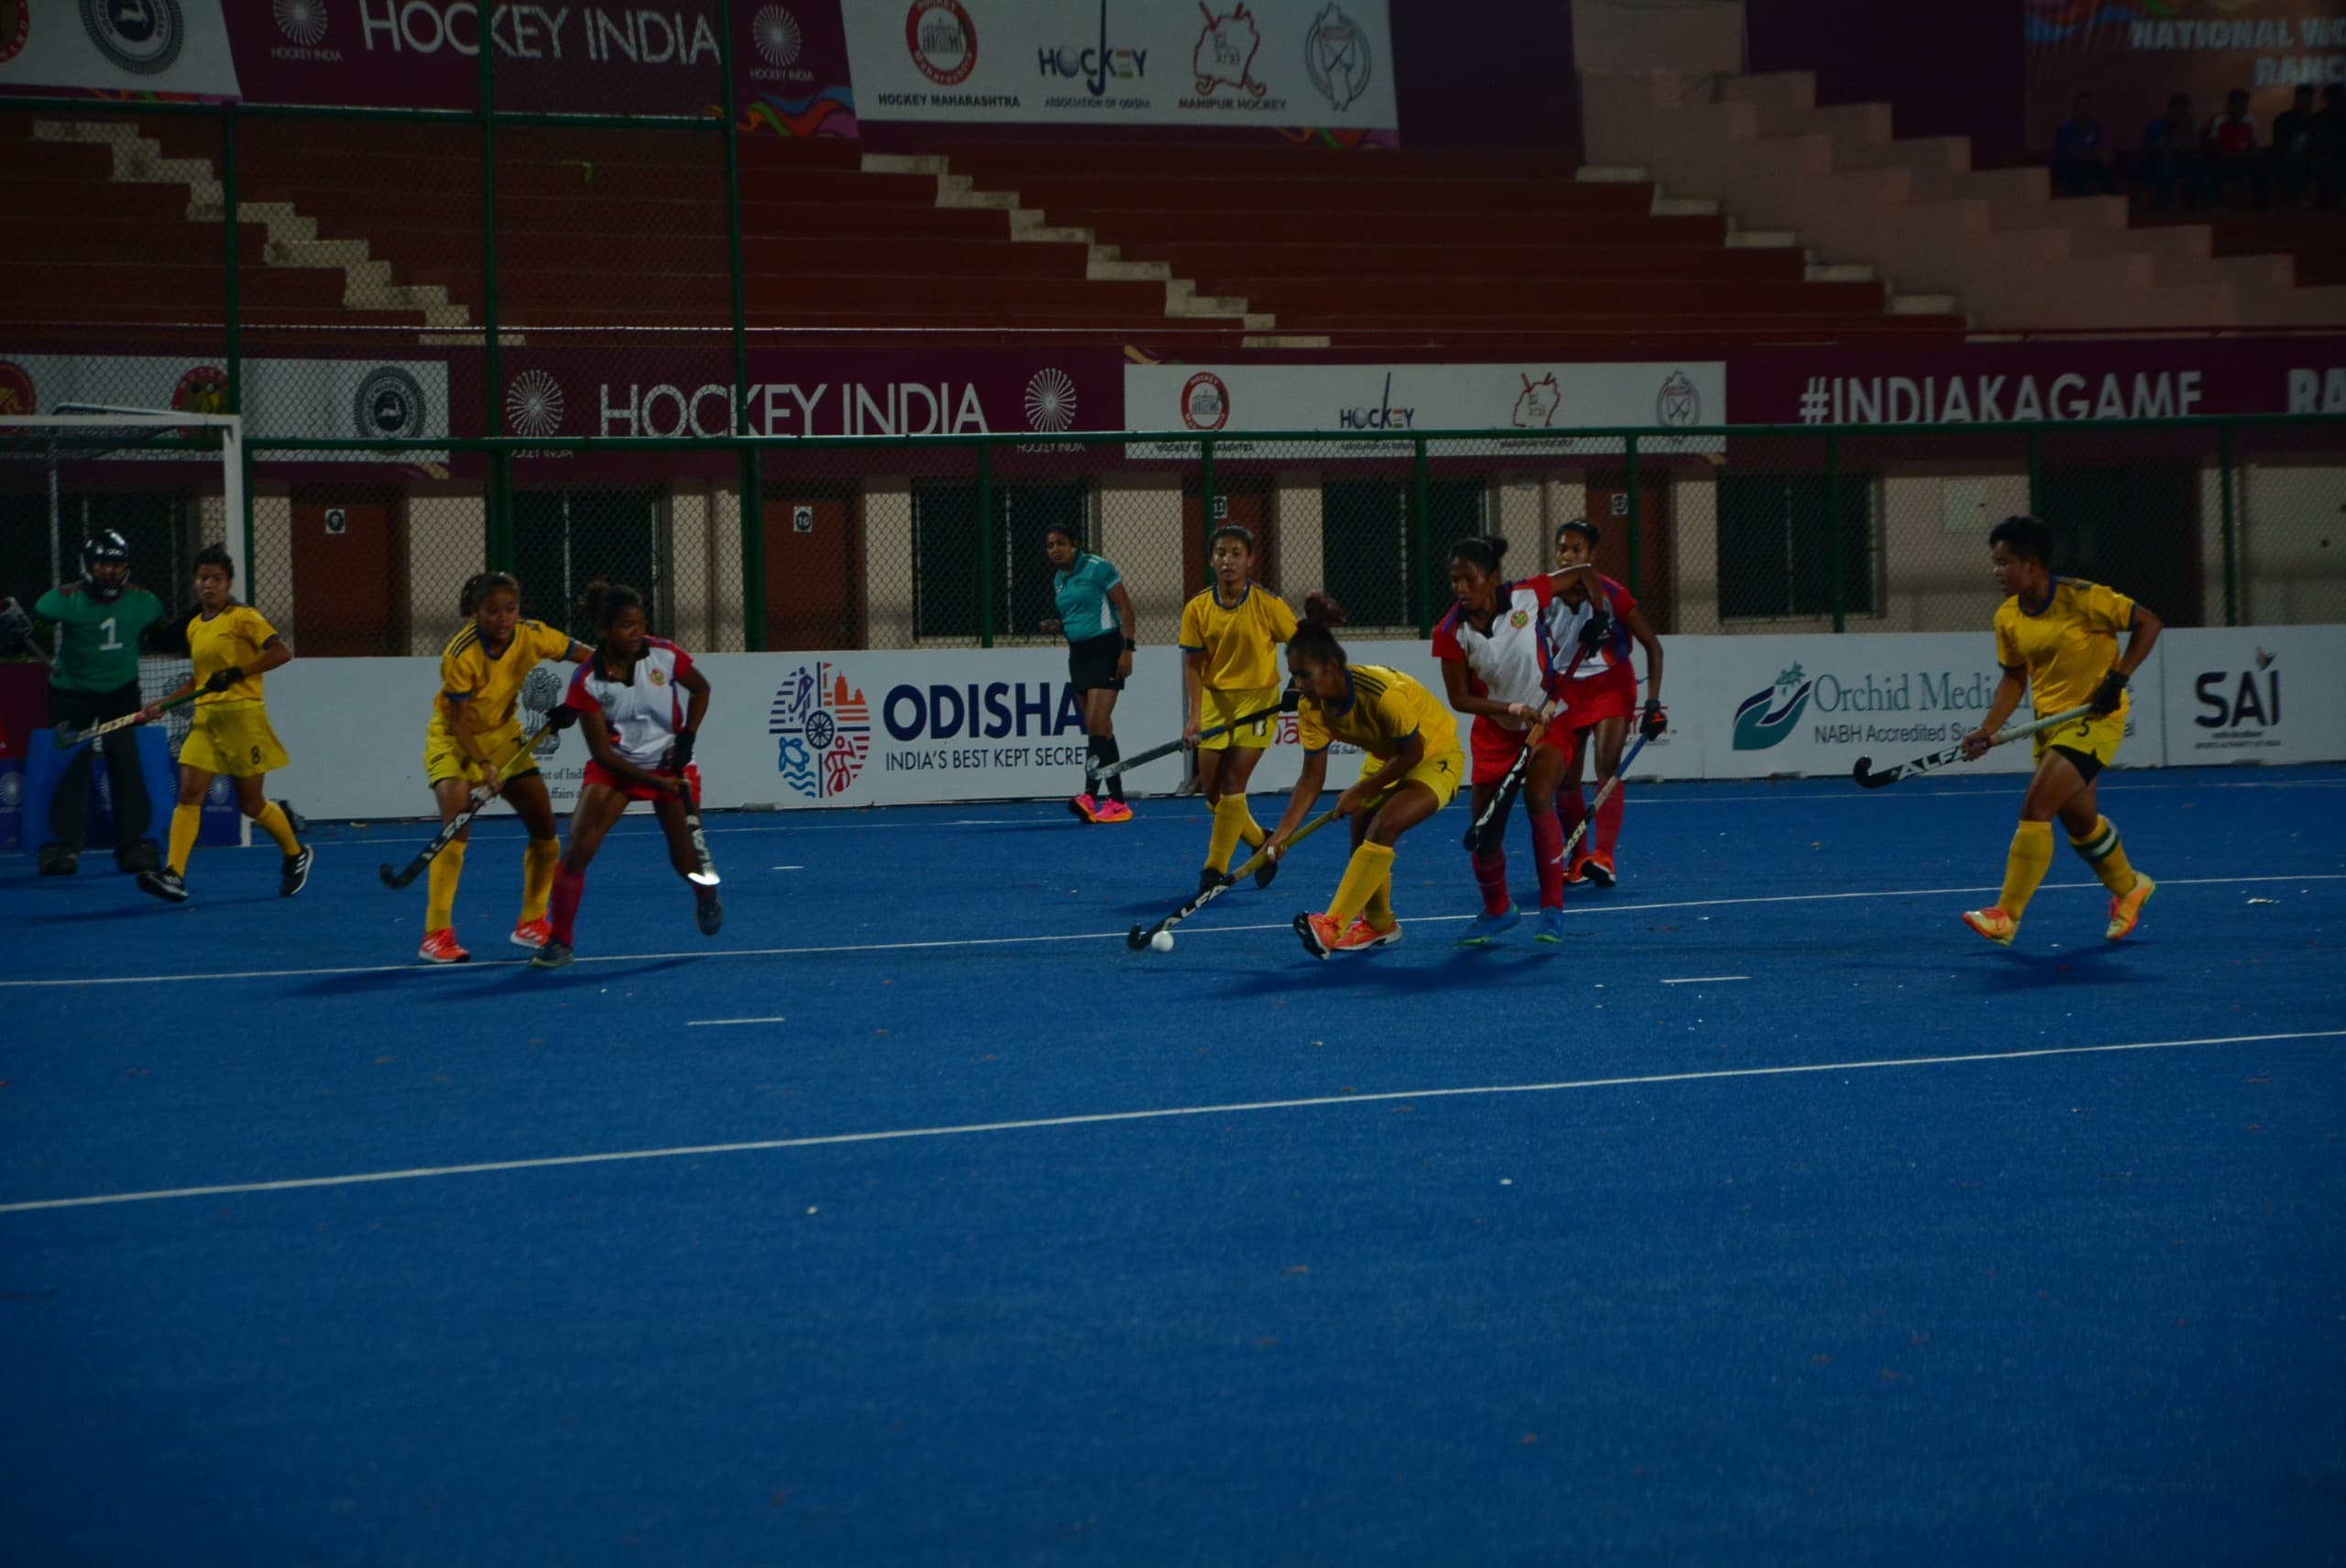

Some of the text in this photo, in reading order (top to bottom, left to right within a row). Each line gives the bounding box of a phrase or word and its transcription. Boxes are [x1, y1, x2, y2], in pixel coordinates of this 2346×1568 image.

[358, 0, 722, 65] HOCKEY INDIA
[2131, 17, 2295, 50] NATIONAL
[750, 69, 785, 81] HOCKEY
[878, 93, 1021, 108] HOCKEY MAHARASHTRA
[1238, 100, 1287, 111] HOCKEY
[600, 381, 990, 437] HOCKEY INDIA
[1799, 371, 2203, 424] #INDIAKAGAME
[98, 617, 124, 652] 1
[1814, 674, 1910, 713] Orchid
[2195, 670, 2281, 728] SAI
[882, 681, 1088, 742] ODISHA
[1814, 725, 1861, 743] NABH
[1866, 723, 1946, 743] Accredited
[2075, 717, 2090, 737] 5
[250, 745, 261, 765] 8
[885, 749, 948, 772] INDIA'S
[952, 749, 989, 769] BEST
[993, 747, 1030, 767] KEPT
[551, 786, 575, 799] ffairs
